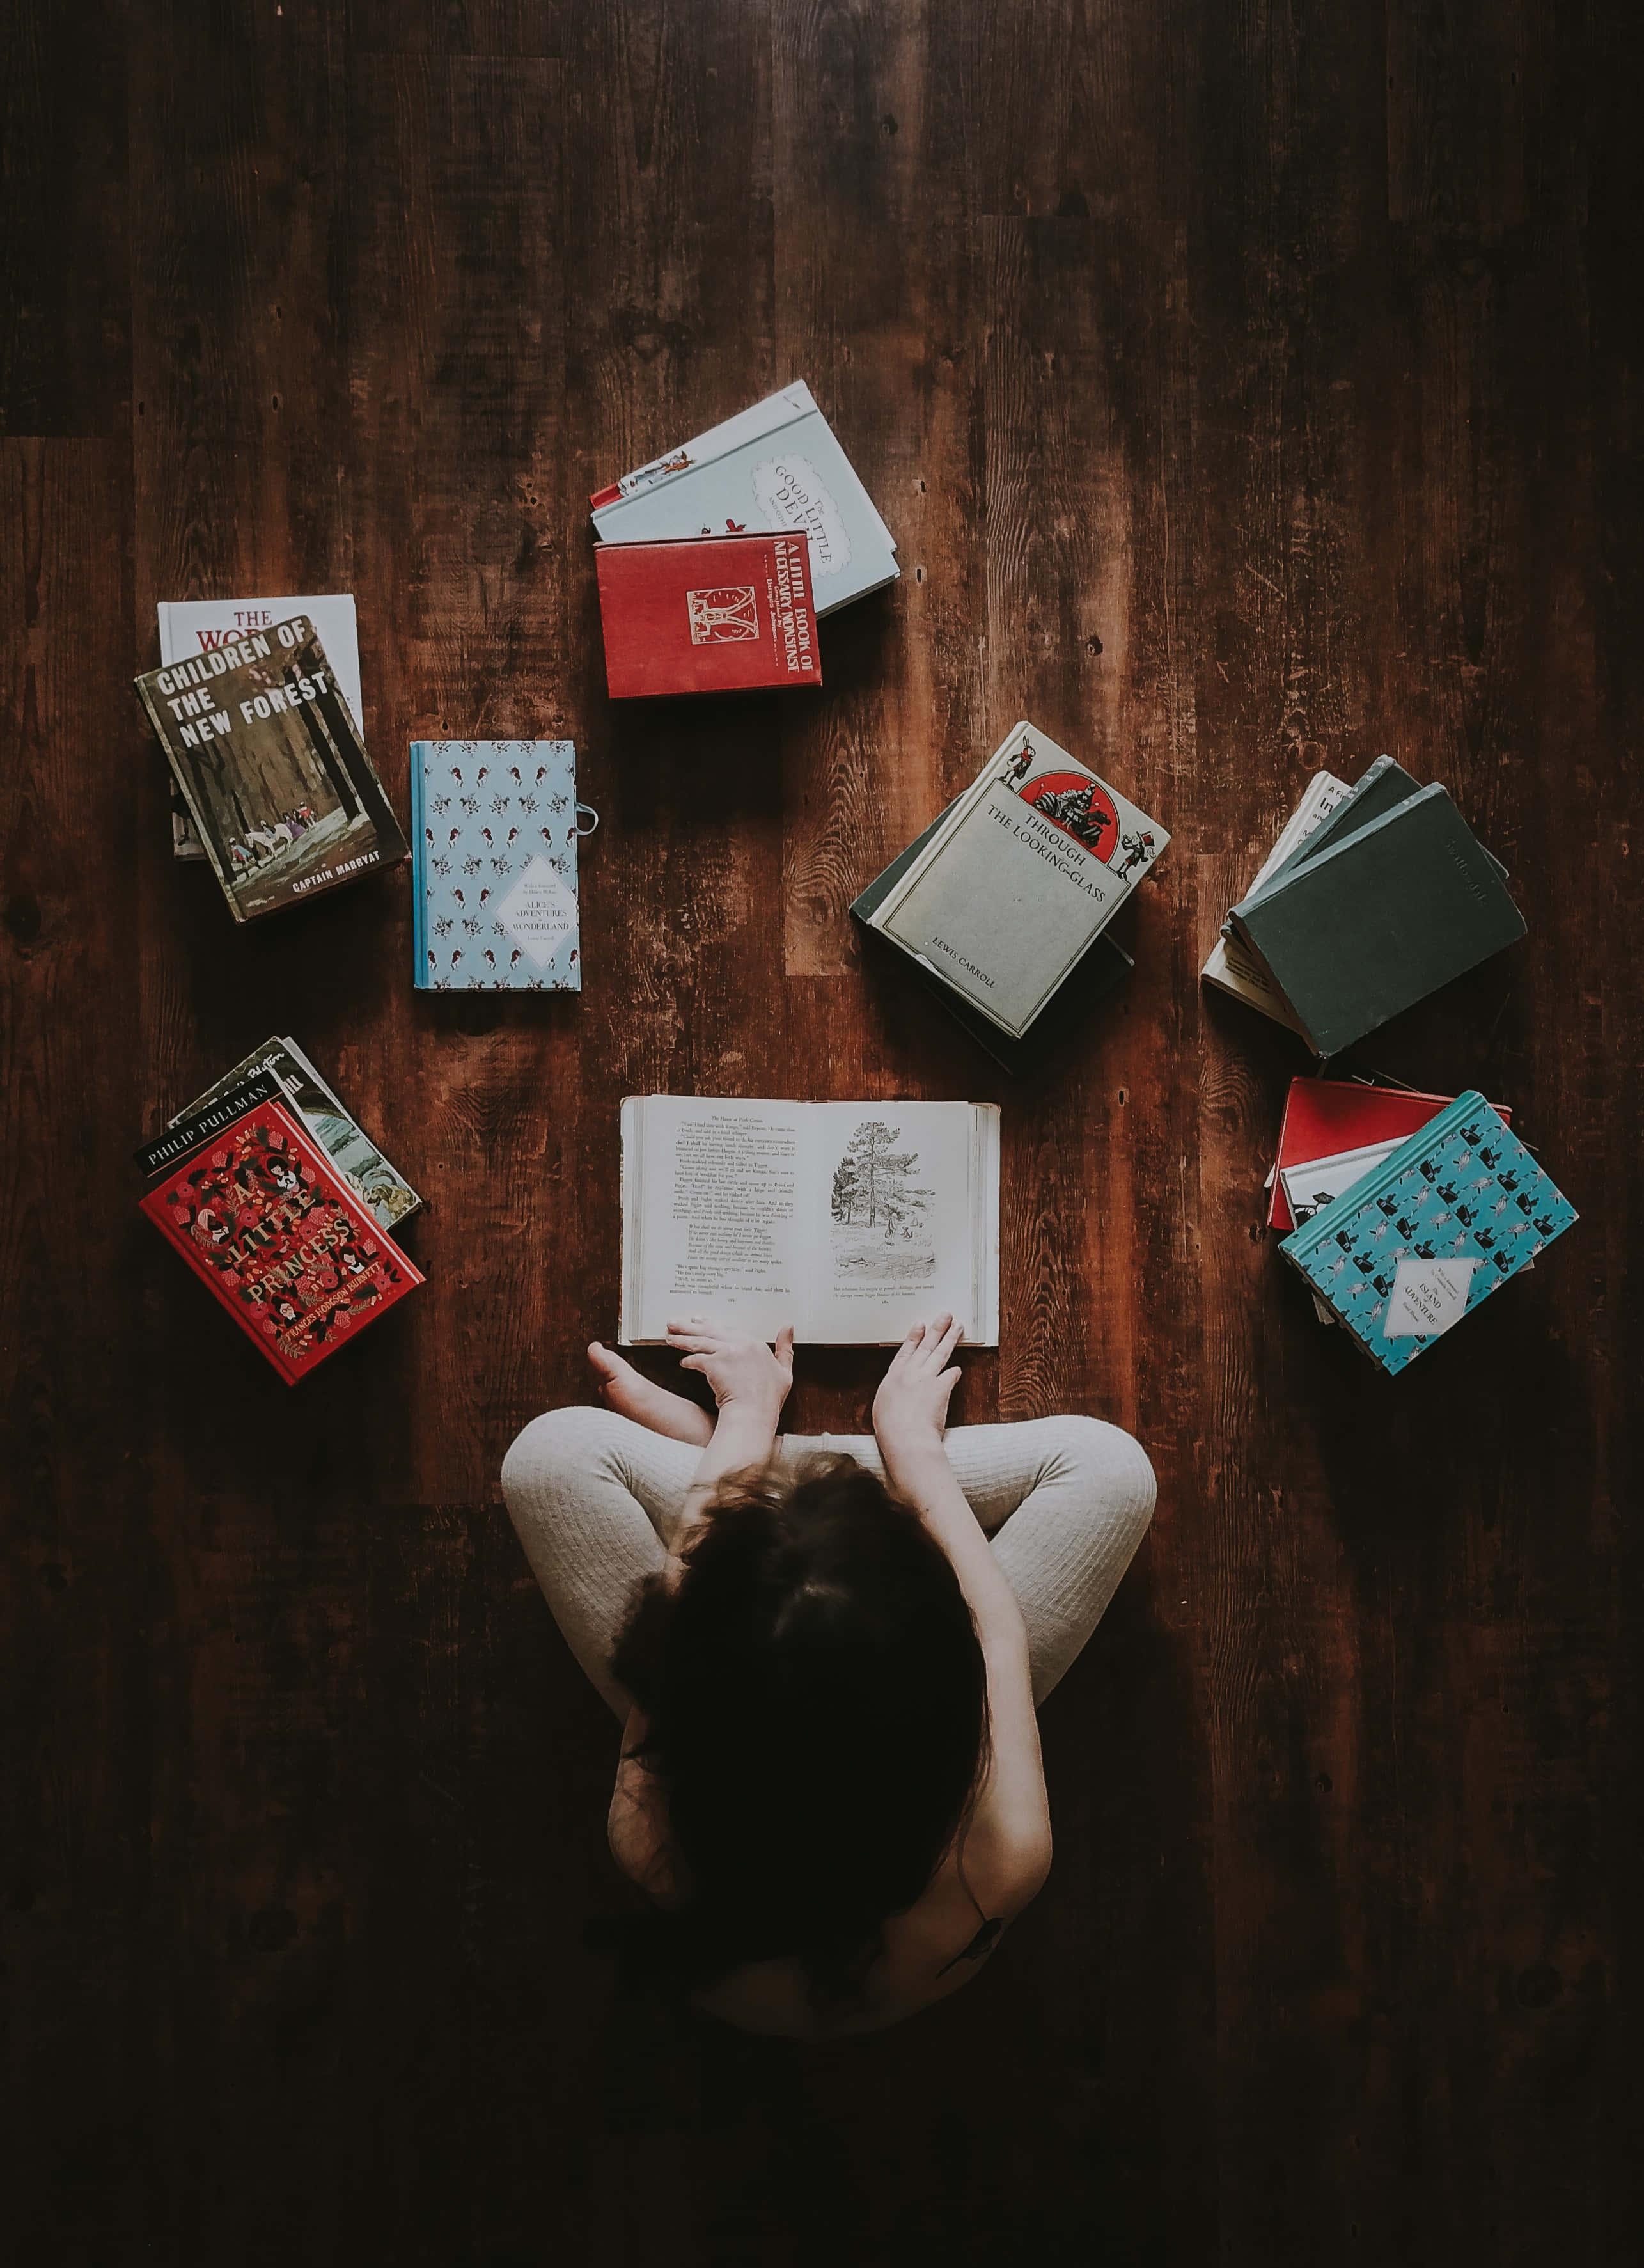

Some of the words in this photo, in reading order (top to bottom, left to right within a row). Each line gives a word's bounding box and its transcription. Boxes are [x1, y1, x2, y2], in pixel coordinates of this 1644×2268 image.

[776, 487, 813, 541] DEV
[776, 466, 808, 504] GOOD
[805, 507, 831, 563] LITTLE
[787, 542, 799, 555] A
[790, 558, 805, 599] LITTLE
[234, 610, 272, 626] THE
[781, 611, 799, 673] NONSENSE
[795, 608, 811, 652] BOOK
[157, 636, 271, 695] CHILDREN
[276, 618, 306, 649] OF
[801, 655, 813, 671] OF
[166, 686, 215, 721] THE
[180, 710, 231, 748] NEW
[239, 672, 329, 725] FOREST
[987, 804, 1013, 830] THE
[1012, 826, 1106, 904] LOOKING-GLASS
[1024, 813, 1086, 867] THROUGH
[292, 869, 333, 894] CAPTAIN
[335, 850, 380, 875] MARRYAT
[932, 936, 959, 960] LEWIS
[958, 957, 996, 989] CARROLL
[146, 1130, 194, 1165] PHILIP
[198, 1084, 269, 1134] PULLMAN
[233, 1182, 254, 1205] A
[228, 1188, 316, 1264] LITTLE
[247, 1219, 350, 1305] PRINCESS
[310, 1277, 326, 1293] BY
[286, 1313, 318, 1341] FRANCES
[315, 1288, 349, 1318] HODGSON
[346, 1261, 382, 1292] BURNETT
[1405, 1286, 1438, 1325] ADVENTURE
[1420, 1283, 1441, 1309] ISLAND
